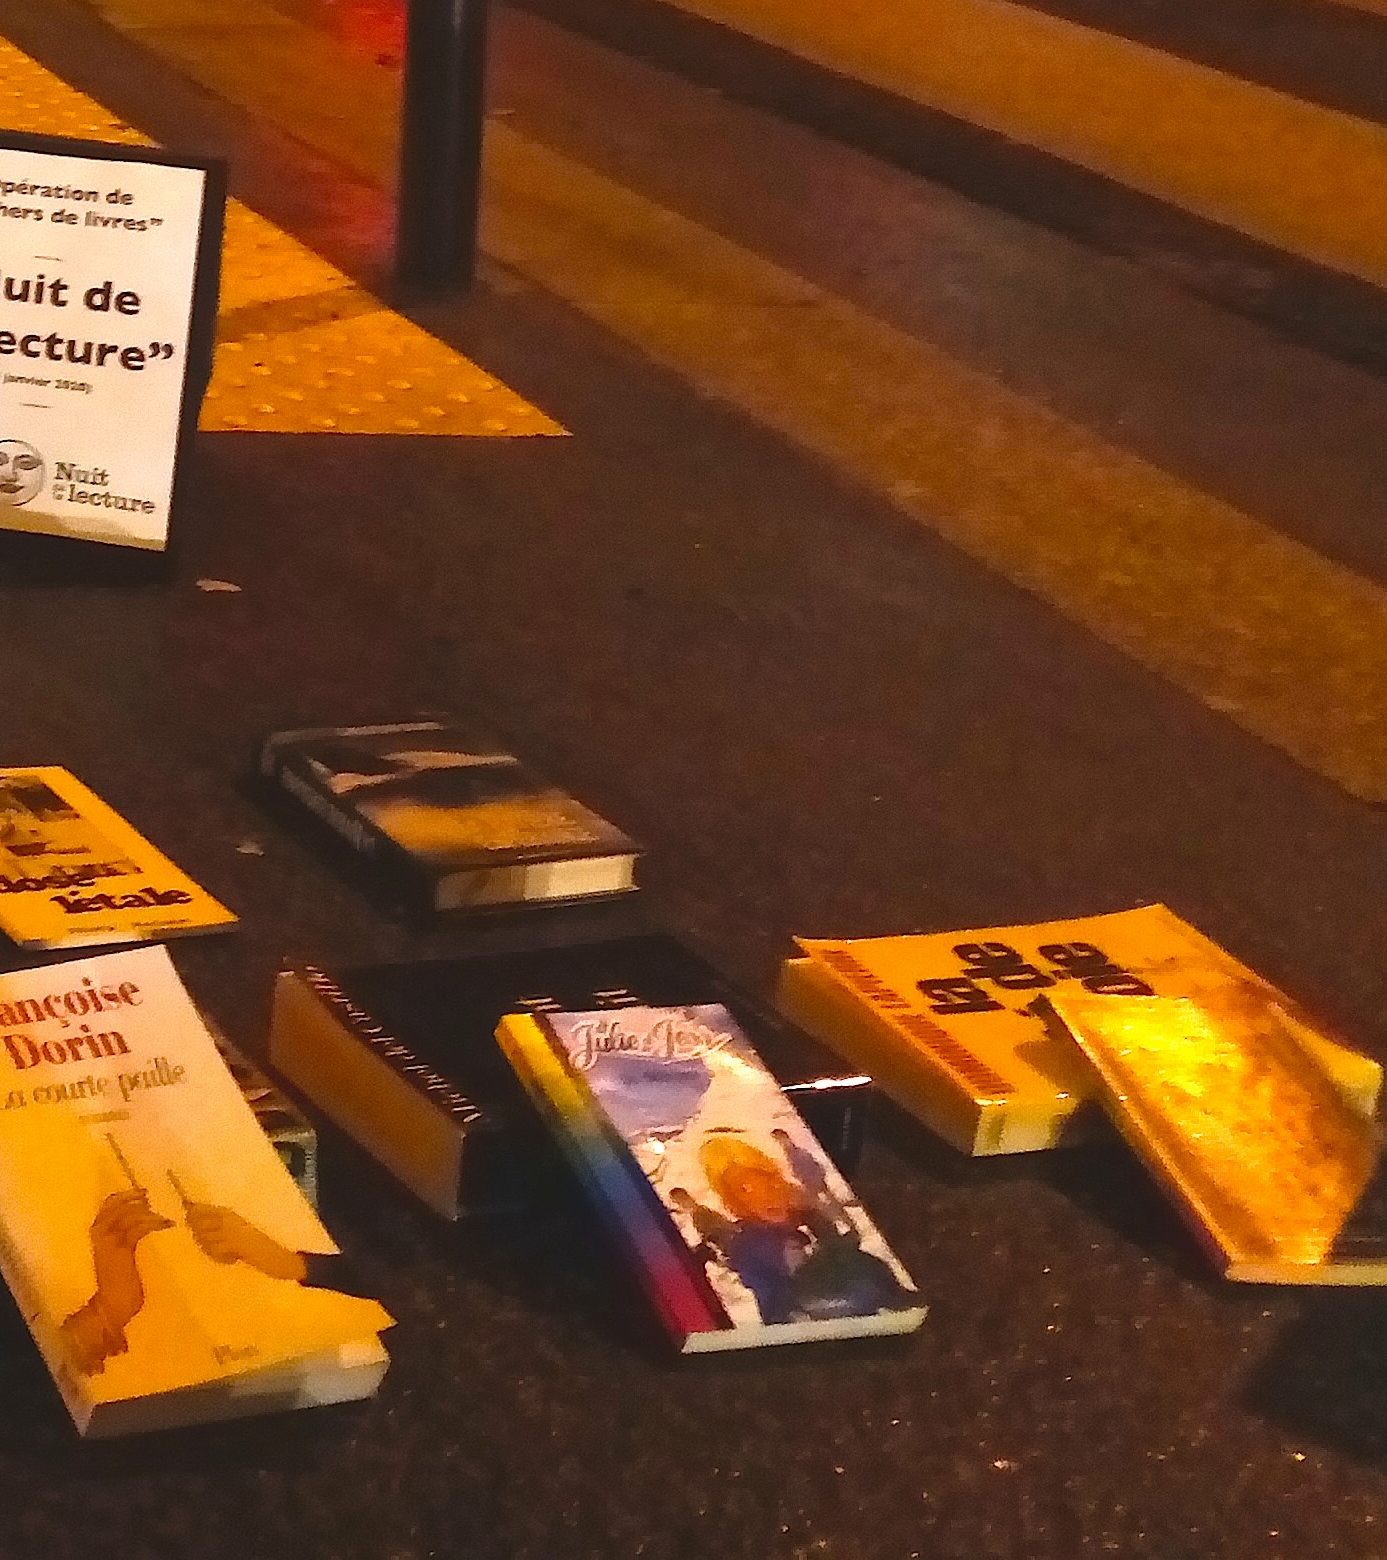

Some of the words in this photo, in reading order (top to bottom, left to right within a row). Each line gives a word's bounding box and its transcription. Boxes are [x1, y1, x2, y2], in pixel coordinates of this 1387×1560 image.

[105, 187, 135, 206] de
[50, 208, 79, 226] de
[83, 280, 142, 316] de
[55, 461, 111, 487] Nuit
[67, 484, 157, 516] lecture
[1, 1022, 133, 1071] Dorin
[32, 1073, 111, 1106] courte
[116, 1056, 191, 1103] paille
